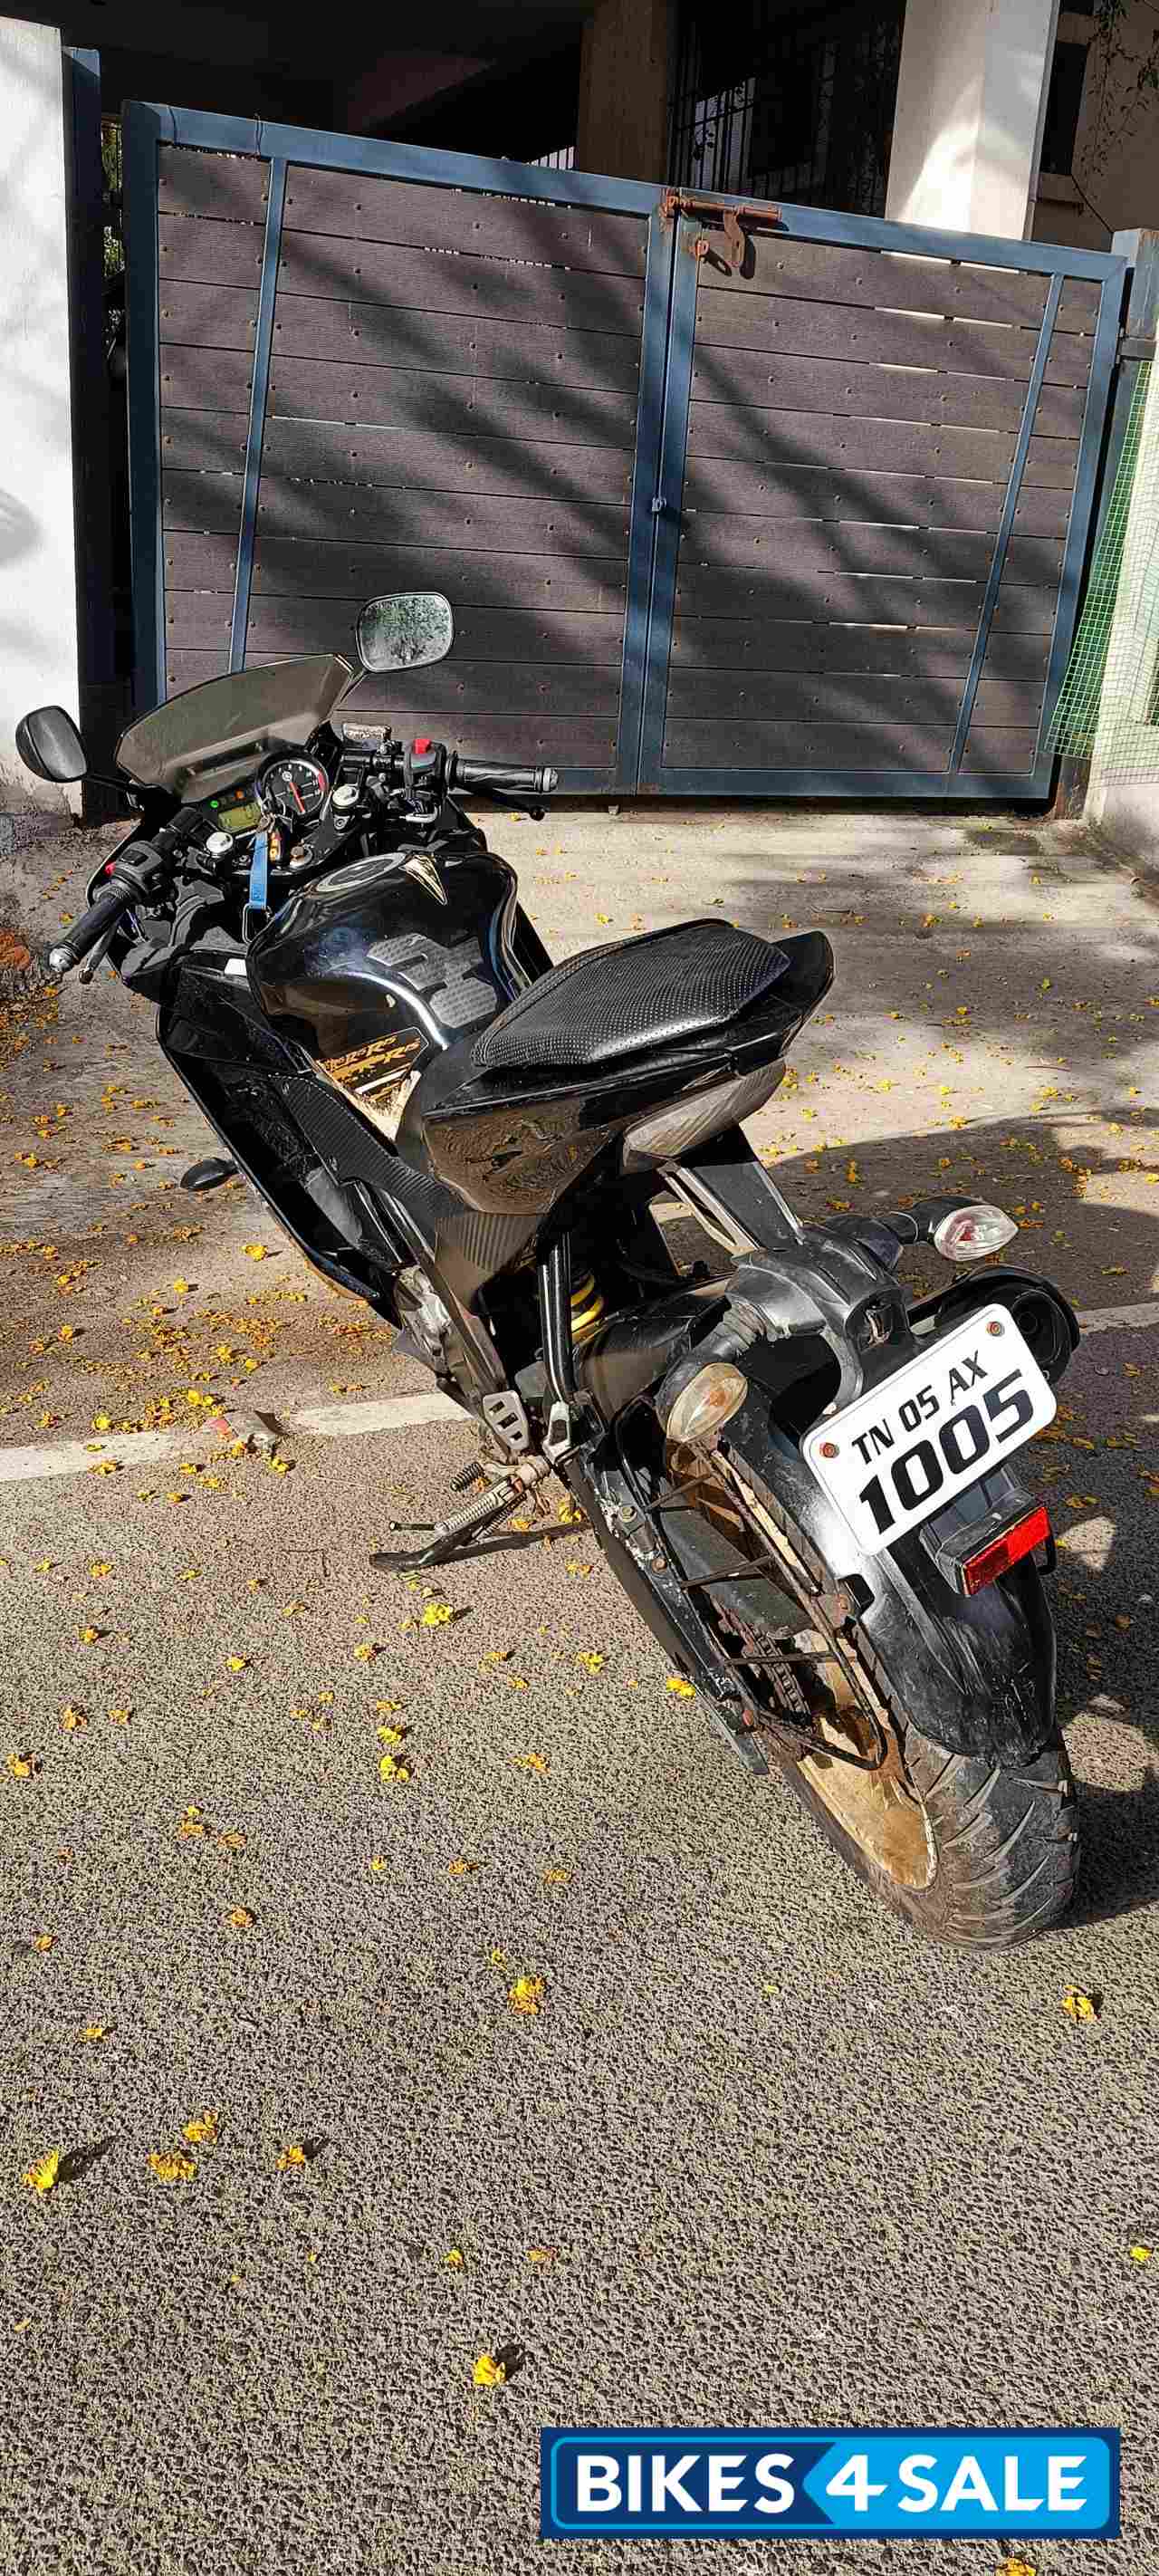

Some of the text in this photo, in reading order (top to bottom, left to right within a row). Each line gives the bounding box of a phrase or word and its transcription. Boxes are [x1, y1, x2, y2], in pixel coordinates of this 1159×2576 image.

[851, 1350, 988, 1465] TN 05 AX
[859, 1369, 1034, 1534] 1005
